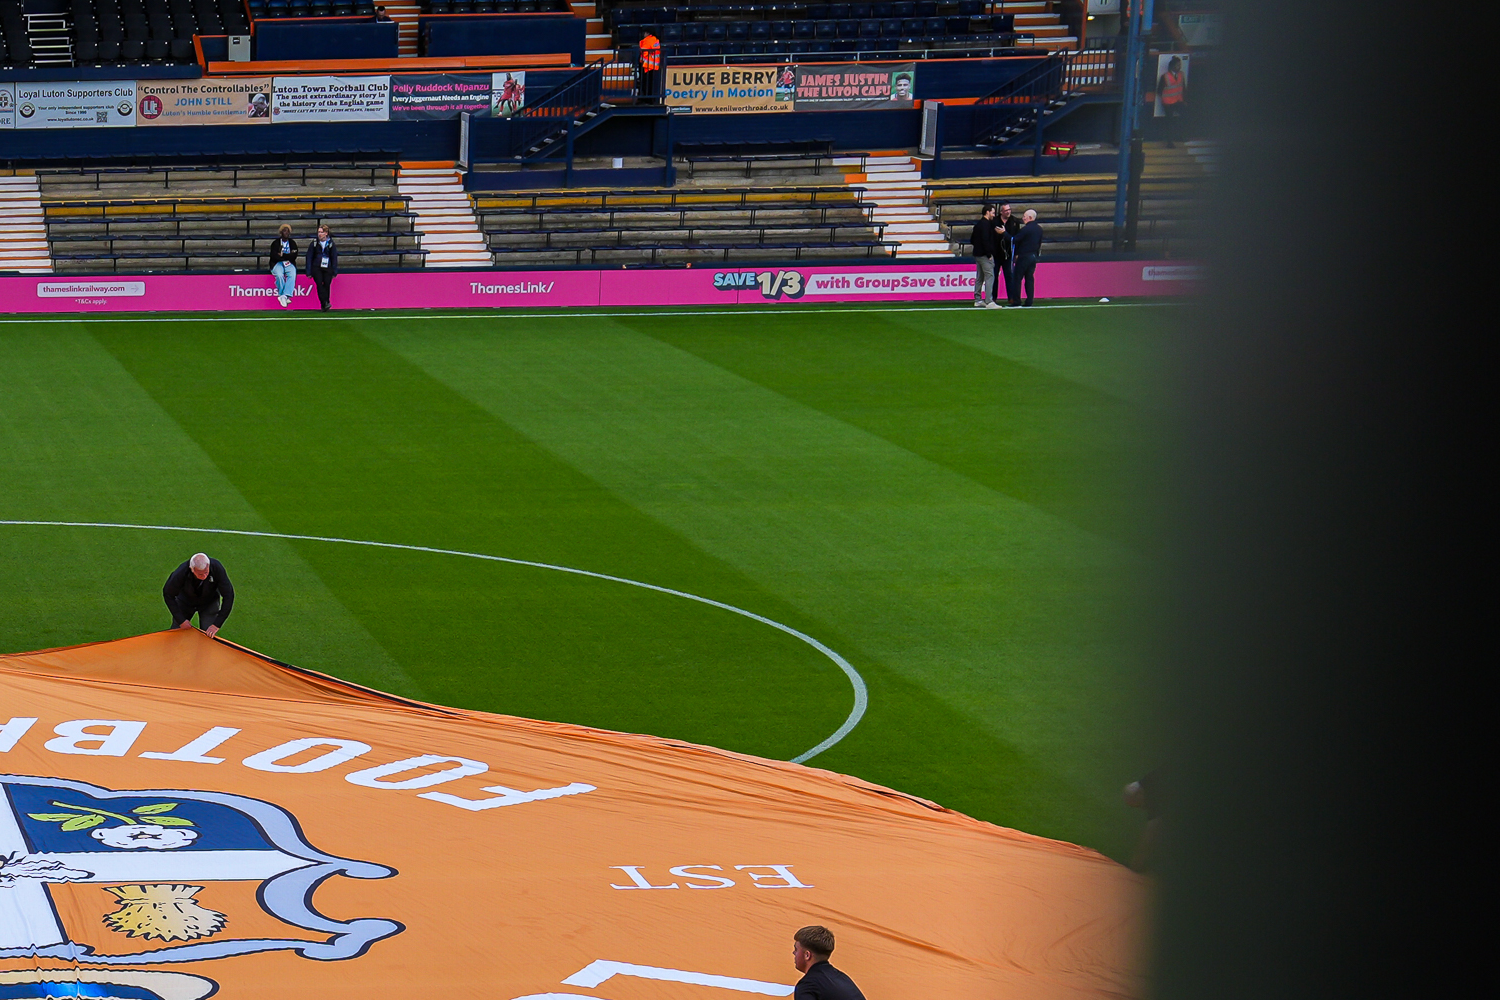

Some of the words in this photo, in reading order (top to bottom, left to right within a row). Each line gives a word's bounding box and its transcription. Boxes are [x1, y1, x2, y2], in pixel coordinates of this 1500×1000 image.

[672, 72, 716, 86] LUKE
[720, 71, 776, 85] BERRY
[800, 75, 841, 86] JAMES
[843, 73, 889, 85] JUSTIN
[19, 90, 40, 99] Loyal
[42, 89, 65, 98] Luton
[66, 89, 113, 99] Supporters
[114, 88, 133, 97] Club
[181, 85, 199, 93] The
[301, 85, 326, 93] Town
[328, 84, 365, 92] Football
[393, 84, 413, 94] Pelly
[415, 84, 453, 92] Ruddock
[455, 84, 490, 92] Mpanzu
[665, 89, 708, 101] Poetry
[711, 87, 724, 98] in
[727, 86, 774, 98] Motion
[796, 87, 820, 97] THE
[821, 86, 860, 97] LUTON
[861, 85, 891, 96] CAFU
[309, 92, 357, 100] extraordinary
[392, 95, 408, 103] Every
[409, 95, 442, 103] Juggernaut
[175, 98, 203, 106] JOHN
[204, 97, 232, 105] STILL
[292, 100, 318, 108] history
[339, 100, 364, 108] English
[426, 104, 449, 112] through
[714, 272, 756, 286] SAVE
[816, 276, 850, 289] with
[854, 273, 936, 291] GroupSave
[939, 274, 977, 287] ticke
[43, 285, 125, 293] thameslinkrailway.com
[610, 865, 814, 890] EST
